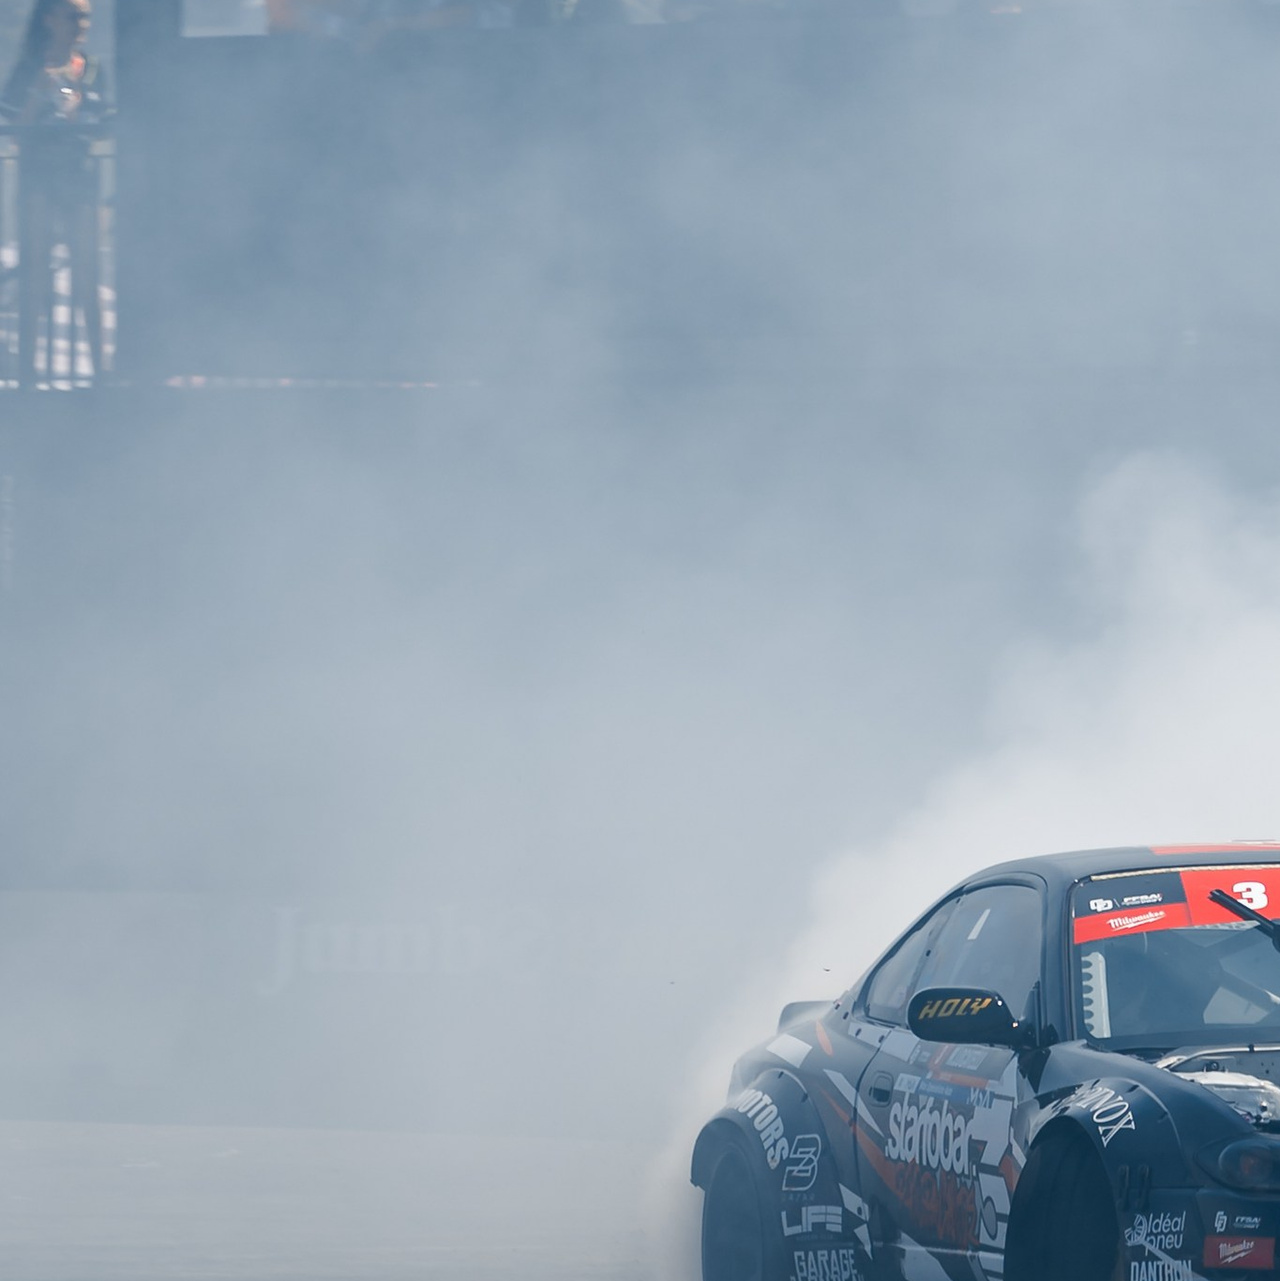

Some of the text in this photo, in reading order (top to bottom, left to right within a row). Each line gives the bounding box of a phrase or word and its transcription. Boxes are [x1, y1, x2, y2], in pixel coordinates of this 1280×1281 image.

[1232, 881, 1268, 910] 3
[918, 997, 993, 1020] HOLY
[735, 1089, 790, 1170] OTORS
[780, 1205, 843, 1238] LIFE
[1148, 1210, 1187, 1234] Idéal
[1146, 1232, 1184, 1257] pneu
[793, 1248, 858, 1279] GARAGE
